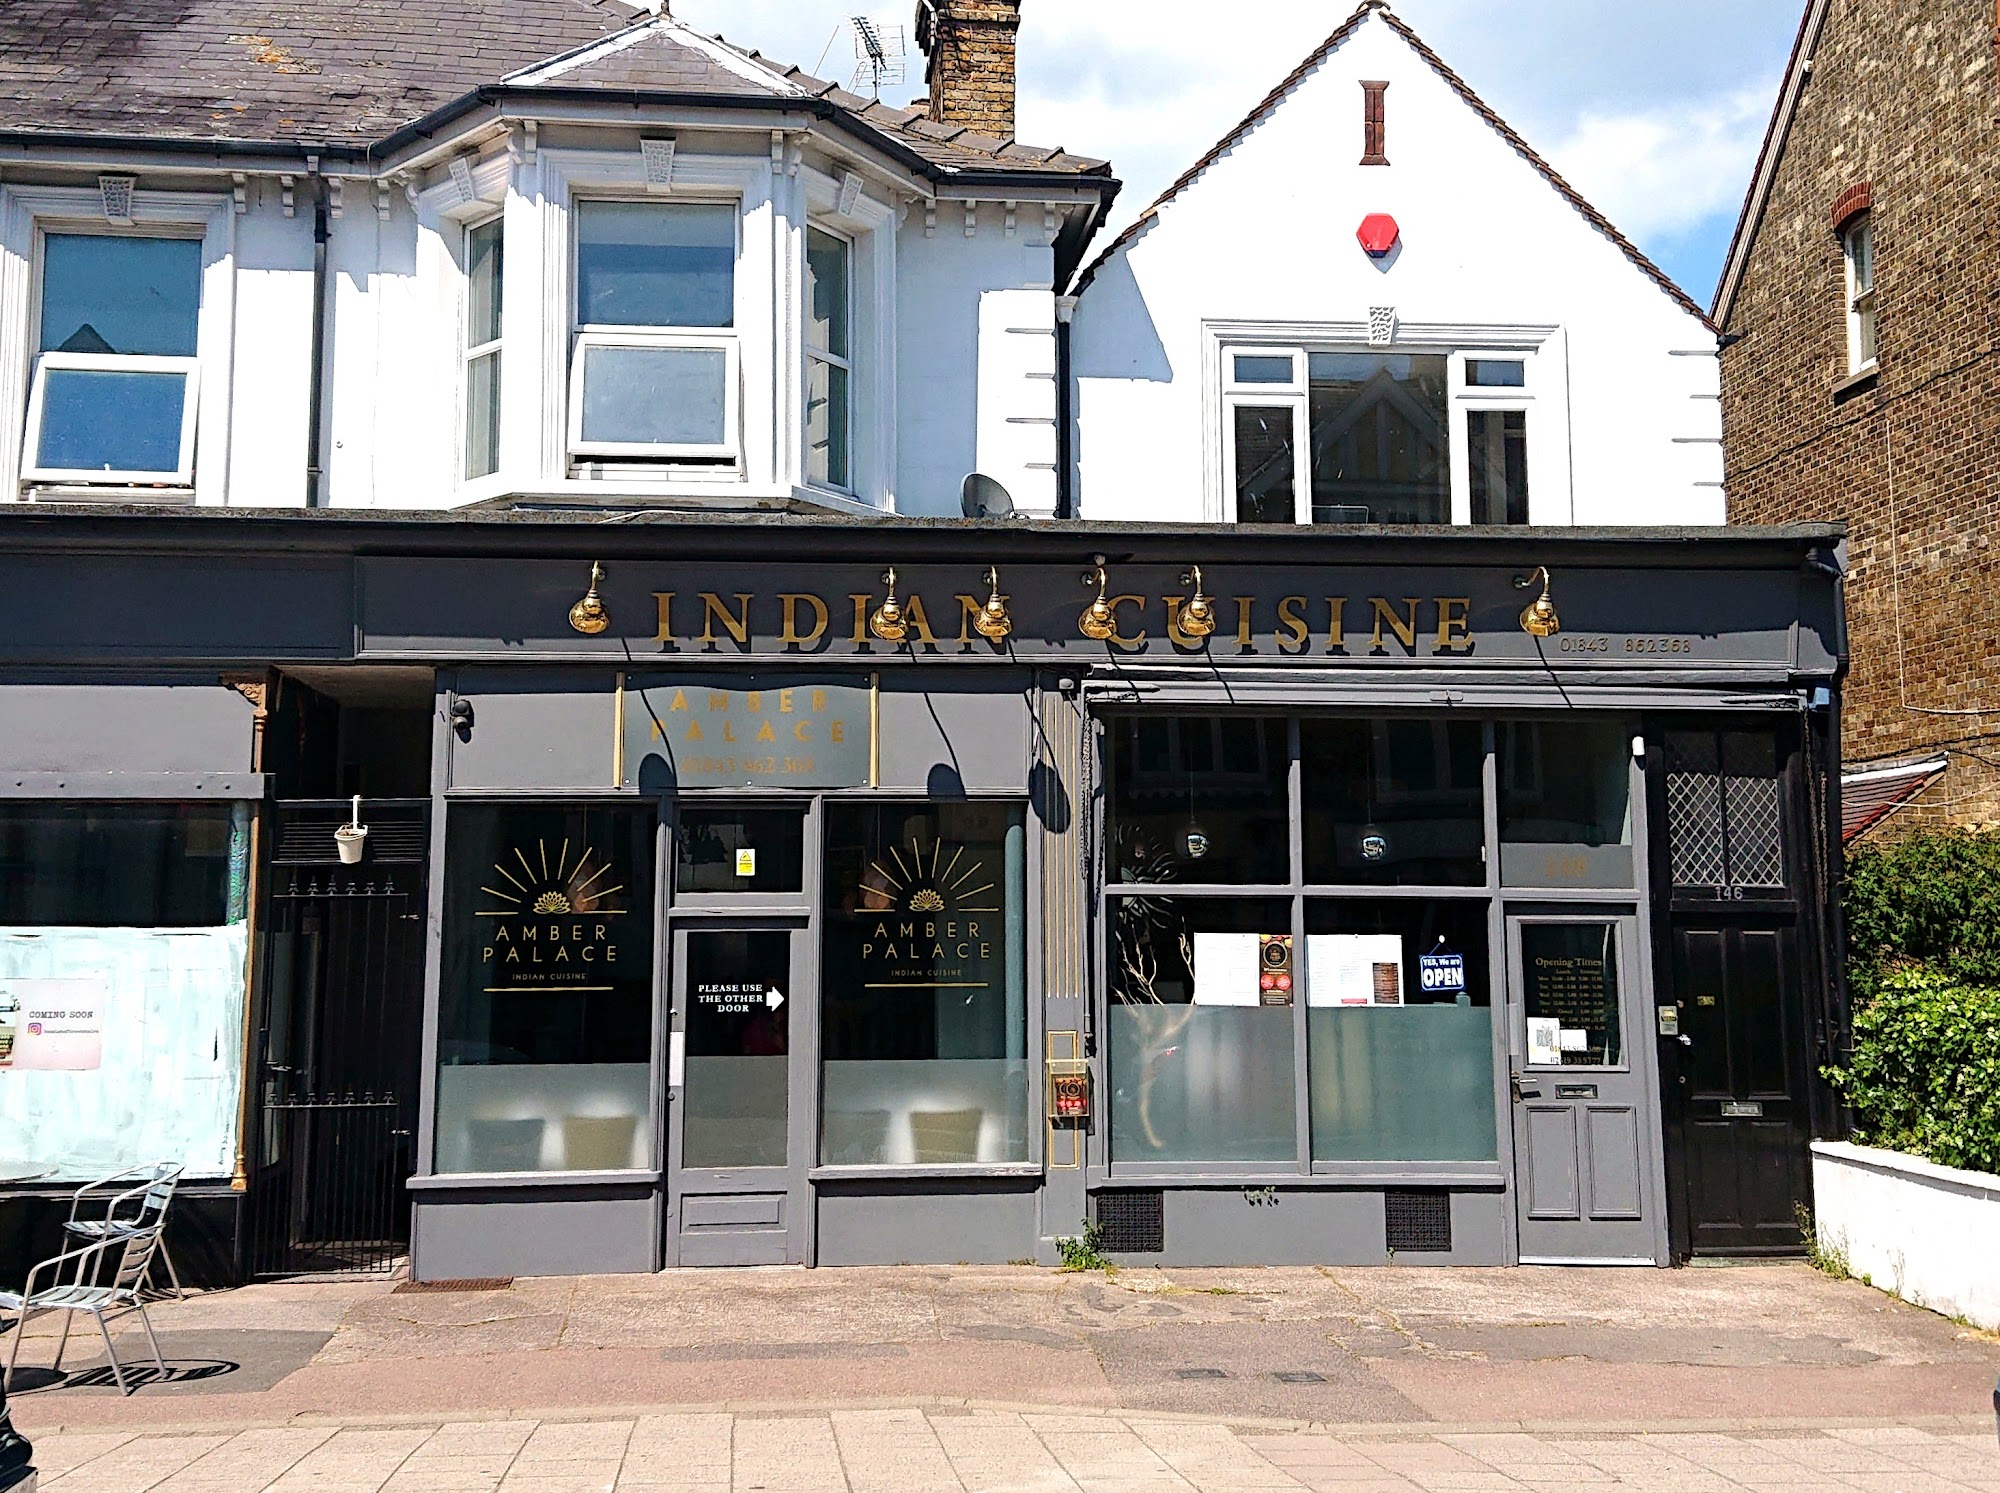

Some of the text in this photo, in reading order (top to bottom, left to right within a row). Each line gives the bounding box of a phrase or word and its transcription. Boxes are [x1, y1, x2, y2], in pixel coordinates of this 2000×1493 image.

[651, 592, 1474, 650] INDIAN CUISINE
[1560, 636, 1691, 654] 01843 862368
[670, 688, 827, 712] AMBER
[650, 720, 845, 742] PALACE
[1715, 886, 1743, 901] 146
[495, 925, 606, 941] AMBER
[874, 922, 979, 938] AMBER
[483, 946, 616, 963] PALACE
[863, 943, 990, 959] PALACE
[1535, 957, 1602, 968] Opening Times
[512, 973, 545, 981] INDIAN
[891, 969, 922, 977] INDIAN
[1423, 967, 1463, 987] OPEN
[698, 984, 763, 992] PLEASE USE
[698, 995, 764, 1003] THE OTHER
[29, 1011, 94, 1019] COMING SOON
[717, 1004, 750, 1013] DOOR
